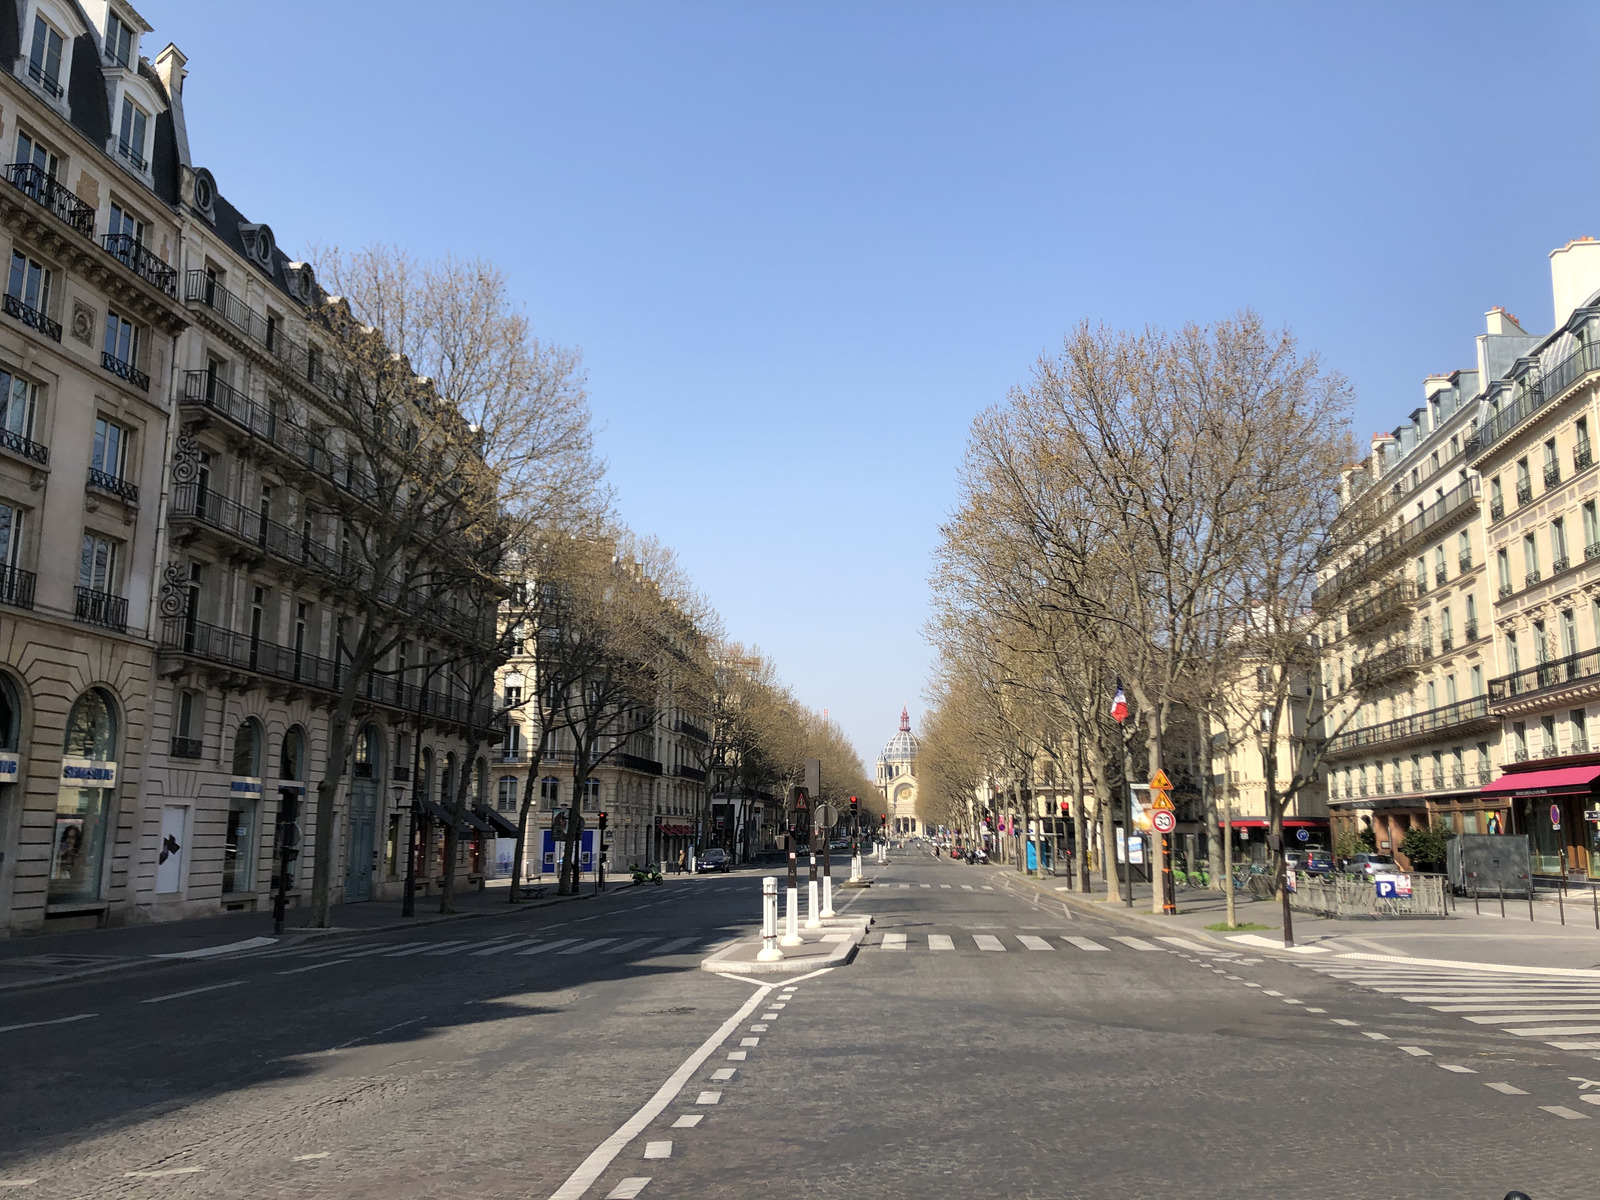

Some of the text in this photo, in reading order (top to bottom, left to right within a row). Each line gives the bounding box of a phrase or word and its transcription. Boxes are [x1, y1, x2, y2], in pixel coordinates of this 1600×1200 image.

[63, 765, 114, 781] SAMSUNG
[1155, 815, 1172, 827] 30
[1380, 882, 1392, 897] P
